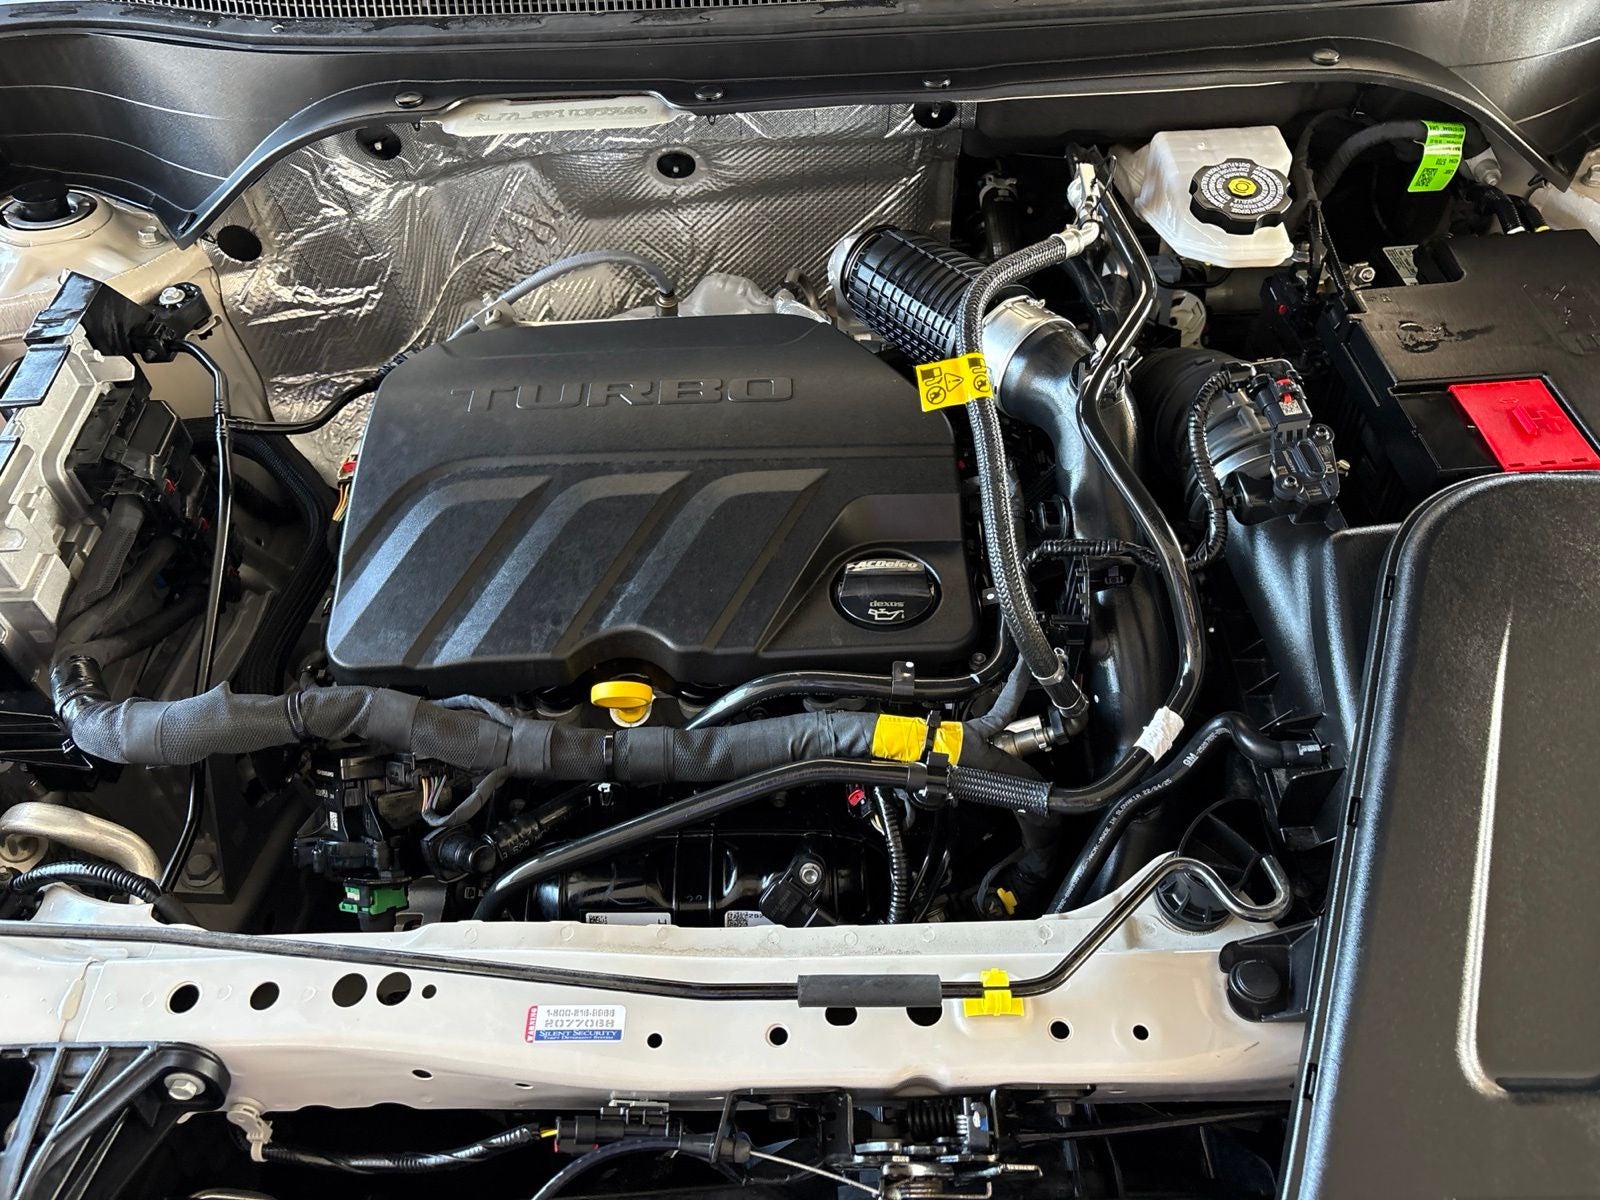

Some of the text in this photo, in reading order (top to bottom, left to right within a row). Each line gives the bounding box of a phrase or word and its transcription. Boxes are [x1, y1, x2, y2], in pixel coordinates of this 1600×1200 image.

[450, 377, 794, 413] TURBO
[855, 560, 919, 569] ACDelco
[869, 599, 905, 608] dexos
